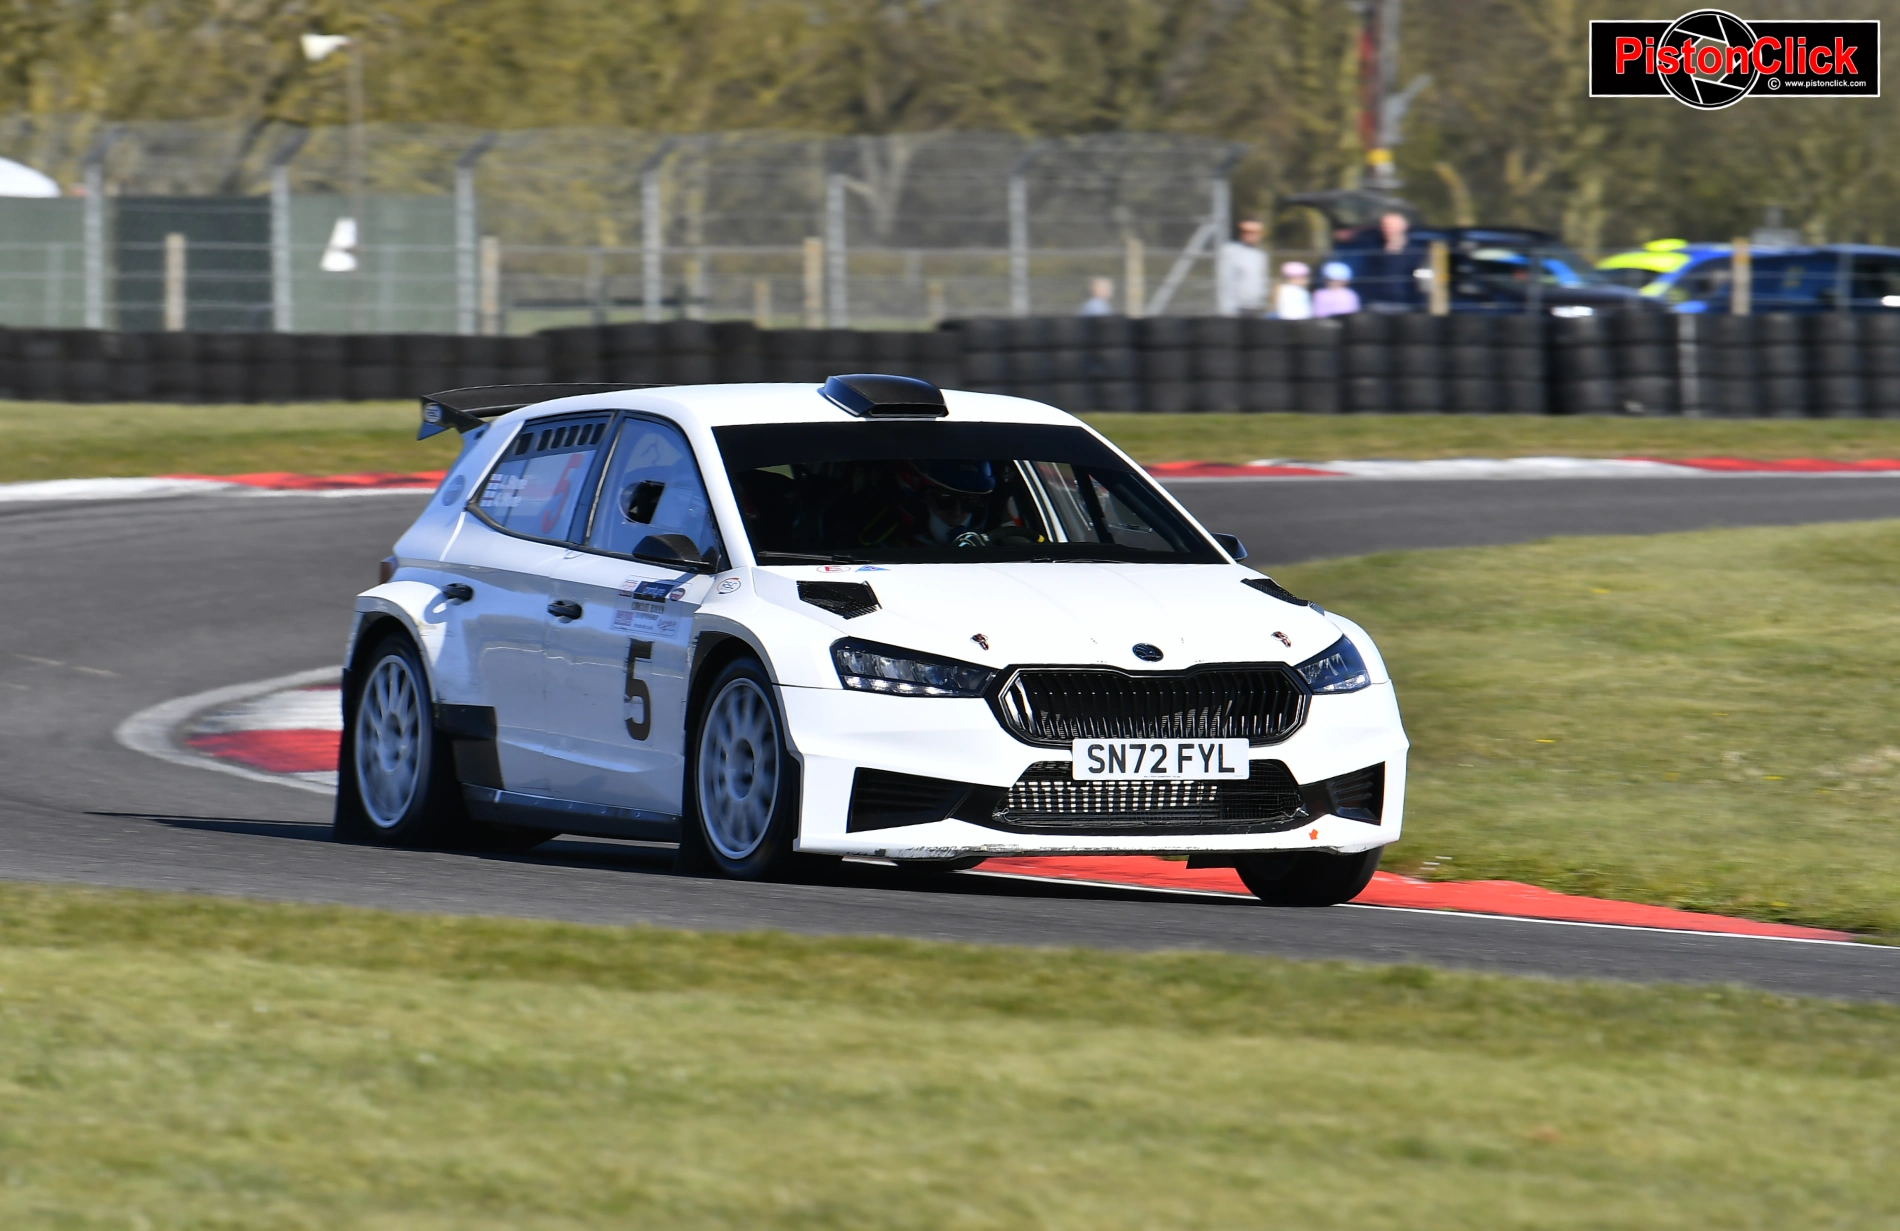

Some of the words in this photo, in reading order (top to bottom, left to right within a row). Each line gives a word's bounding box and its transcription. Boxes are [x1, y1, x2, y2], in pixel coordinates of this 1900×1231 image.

[540, 453, 584, 534] 5
[624, 637, 654, 742] 5
[1087, 743, 1167, 774] SN72
[1177, 743, 1235, 774] FYL
